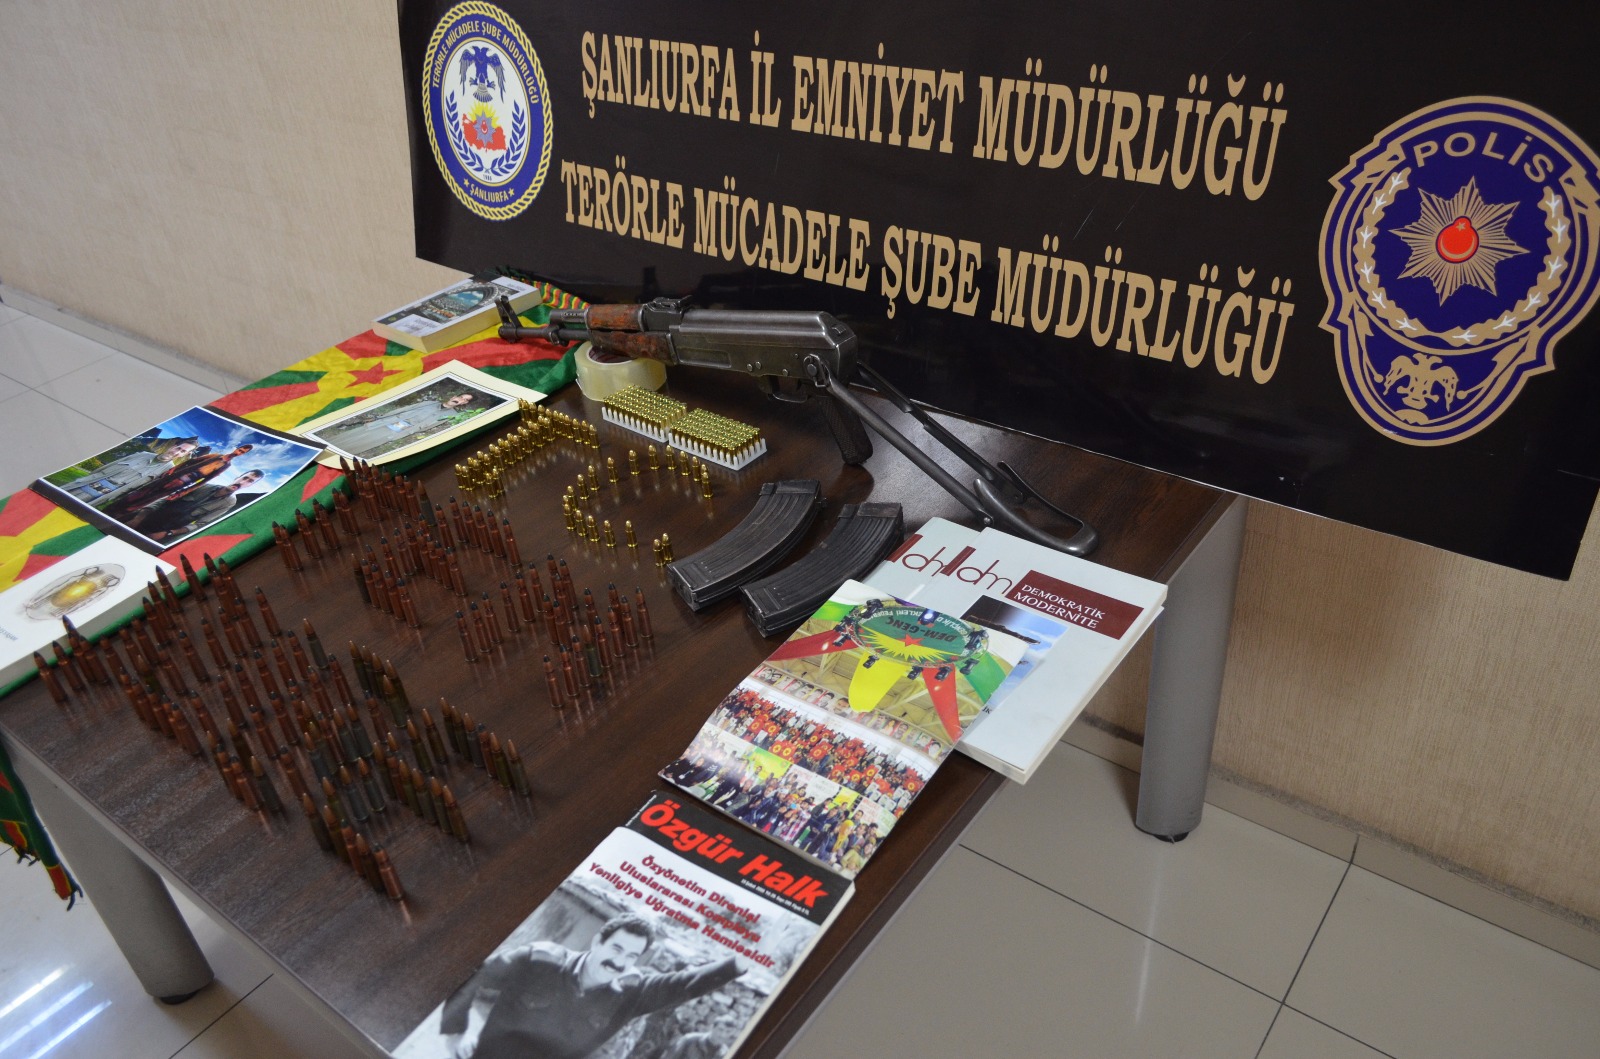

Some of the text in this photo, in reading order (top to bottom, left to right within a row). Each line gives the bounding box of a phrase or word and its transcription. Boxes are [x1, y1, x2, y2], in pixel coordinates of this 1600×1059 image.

[432, 20, 540, 104] TERÖRLE MÜCADELE ŞUBE MÜDÜRLÜĞÜ
[581, 30, 1288, 201] ŞANLIURFA İL EMNİYET MÜDÜRLÜĞÜ
[1413, 132, 1555, 183] POLİS
[469, 183, 509, 202] ŞANLIURFA
[561, 154, 1295, 385] TERÖRLE MÜCADELE ŞUBE MÜDÜRLÜĞÜ
[1013, 592, 1100, 629] MODERNİTE
[1021, 584, 1106, 620] DEMOKRATİK
[619, 861, 695, 908] Uluslararası
[640, 800, 744, 864] Özgür
[738, 854, 829, 908] Halk
[589, 862, 643, 899] Yenilgiye
[645, 895, 700, 930] Uğratma
[701, 924, 776, 968] Hamlesidir
[641, 855, 707, 896] Özyönetim
[708, 891, 761, 923] Direnişi
